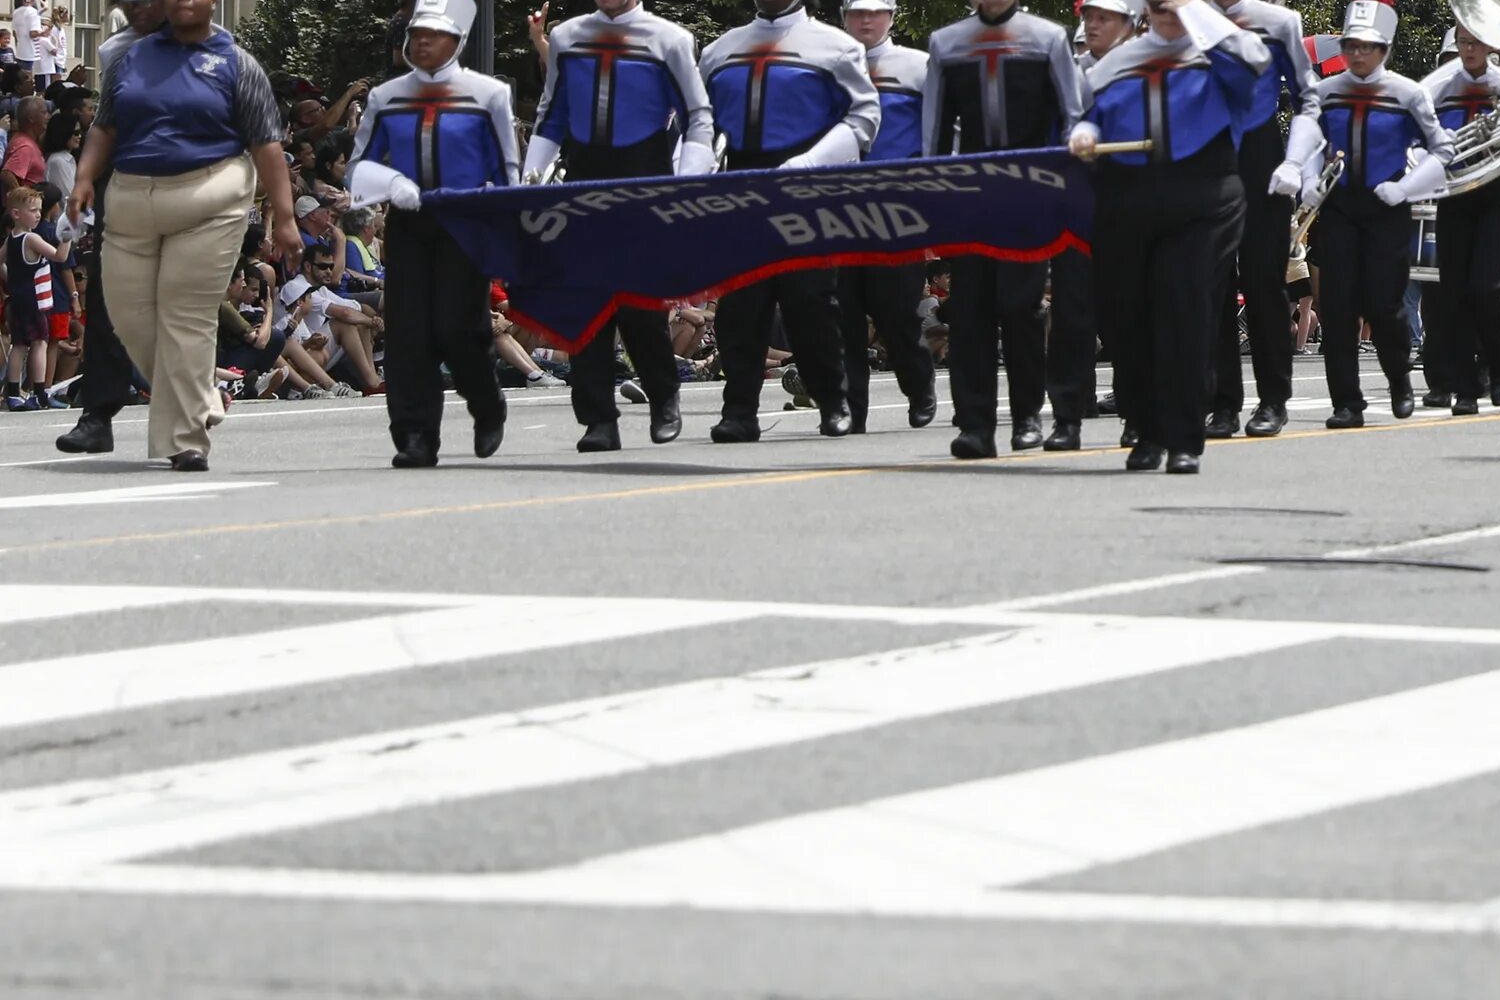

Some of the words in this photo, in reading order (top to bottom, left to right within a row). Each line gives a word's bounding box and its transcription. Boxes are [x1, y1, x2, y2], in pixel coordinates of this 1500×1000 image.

[650, 190, 771, 224] HIGH
[780, 177, 981, 199] SCHOOL
[769, 202, 930, 246] BAND
